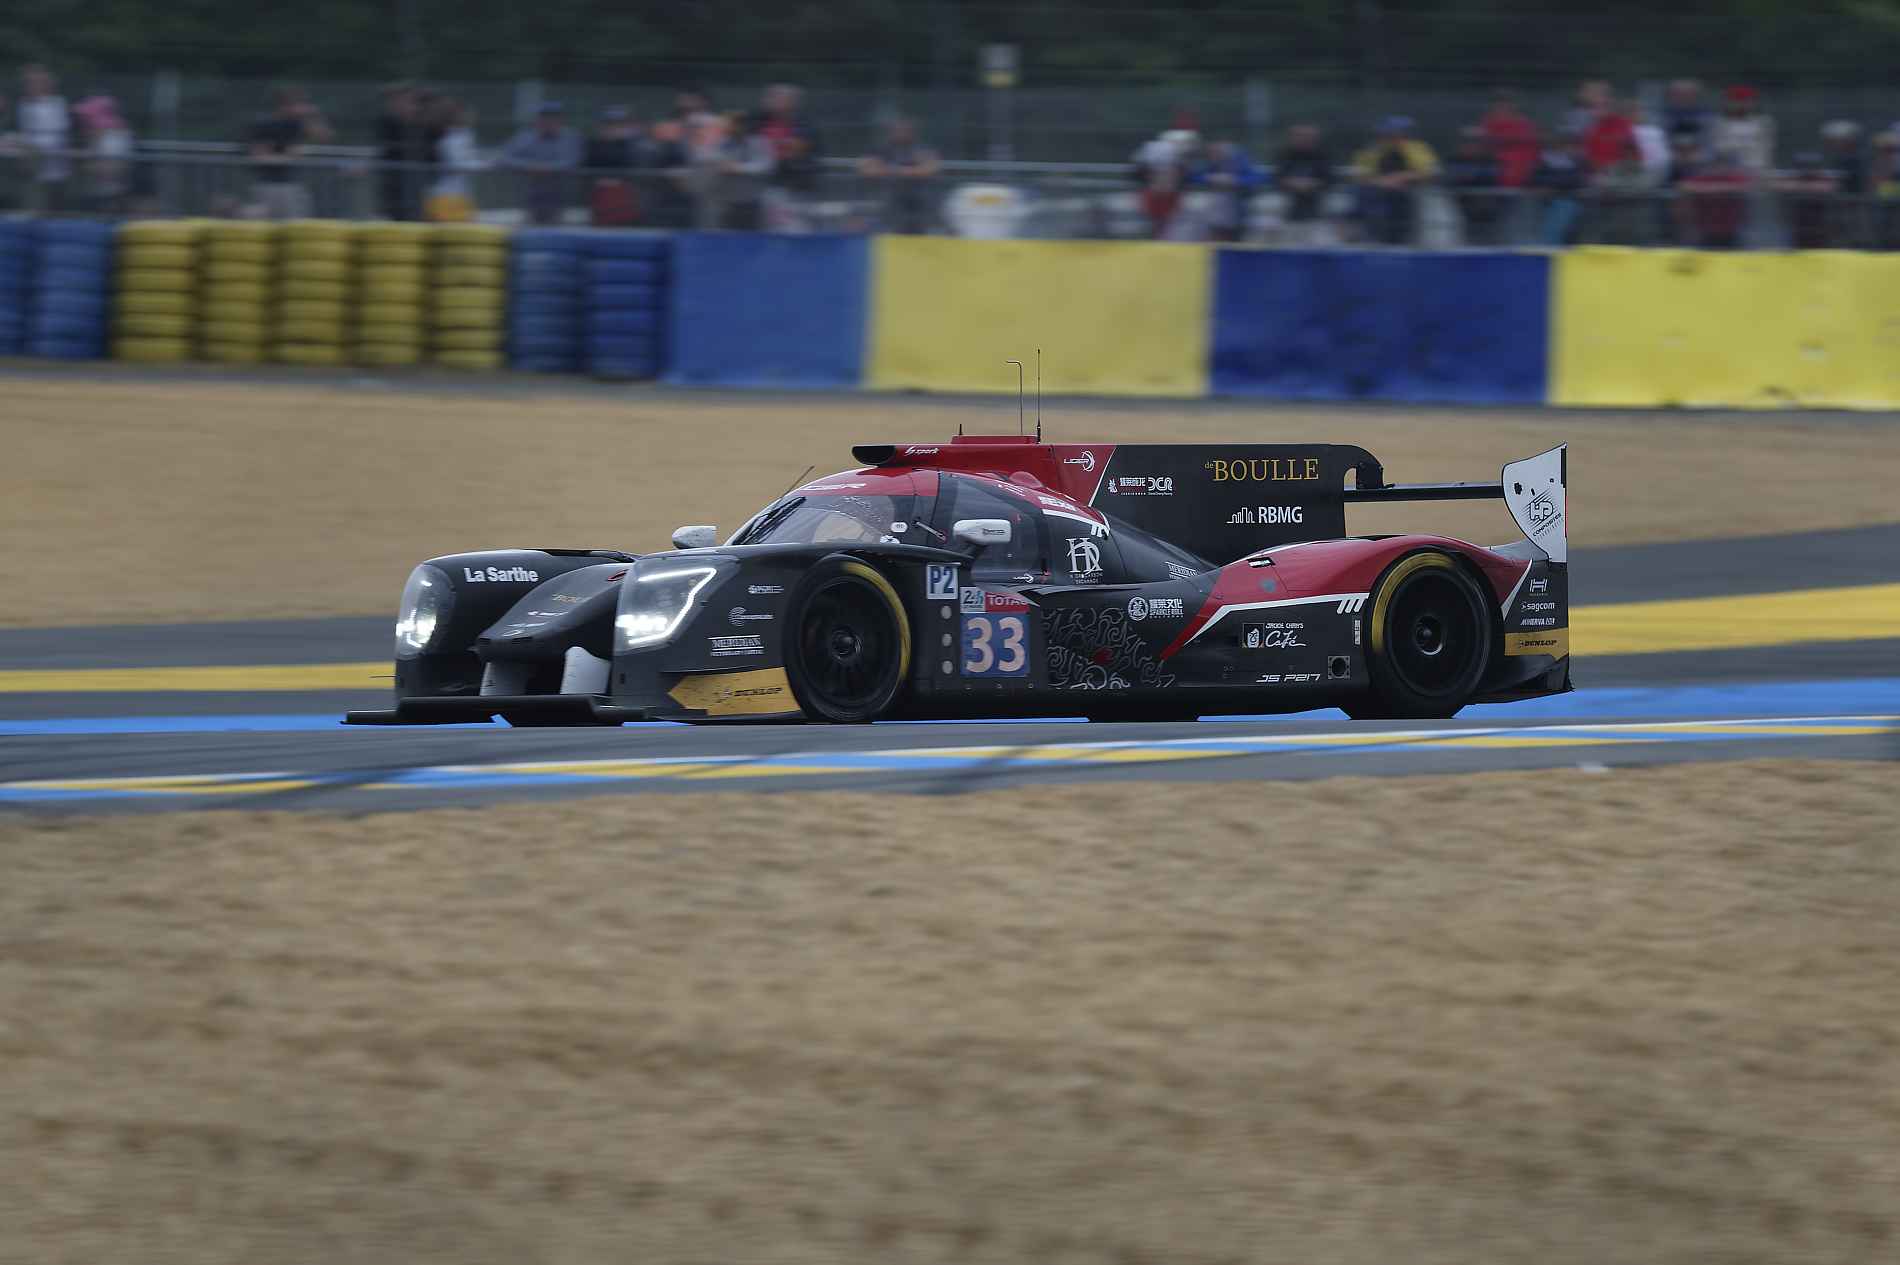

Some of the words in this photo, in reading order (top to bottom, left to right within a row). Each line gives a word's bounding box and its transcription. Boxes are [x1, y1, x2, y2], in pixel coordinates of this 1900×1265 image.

[1213, 459, 1319, 481] BOULLE
[1258, 506, 1303, 524] RBMG
[464, 567, 485, 582] La
[486, 567, 539, 582] Sarthe
[930, 565, 955, 594] P2
[1527, 602, 1555, 612] sagcom
[966, 616, 1026, 673] 33
[1524, 640, 1557, 648] DUNLOP
[1256, 674, 1280, 682] JS
[1283, 673, 1321, 682] P217
[734, 687, 783, 697] DUNLOP
